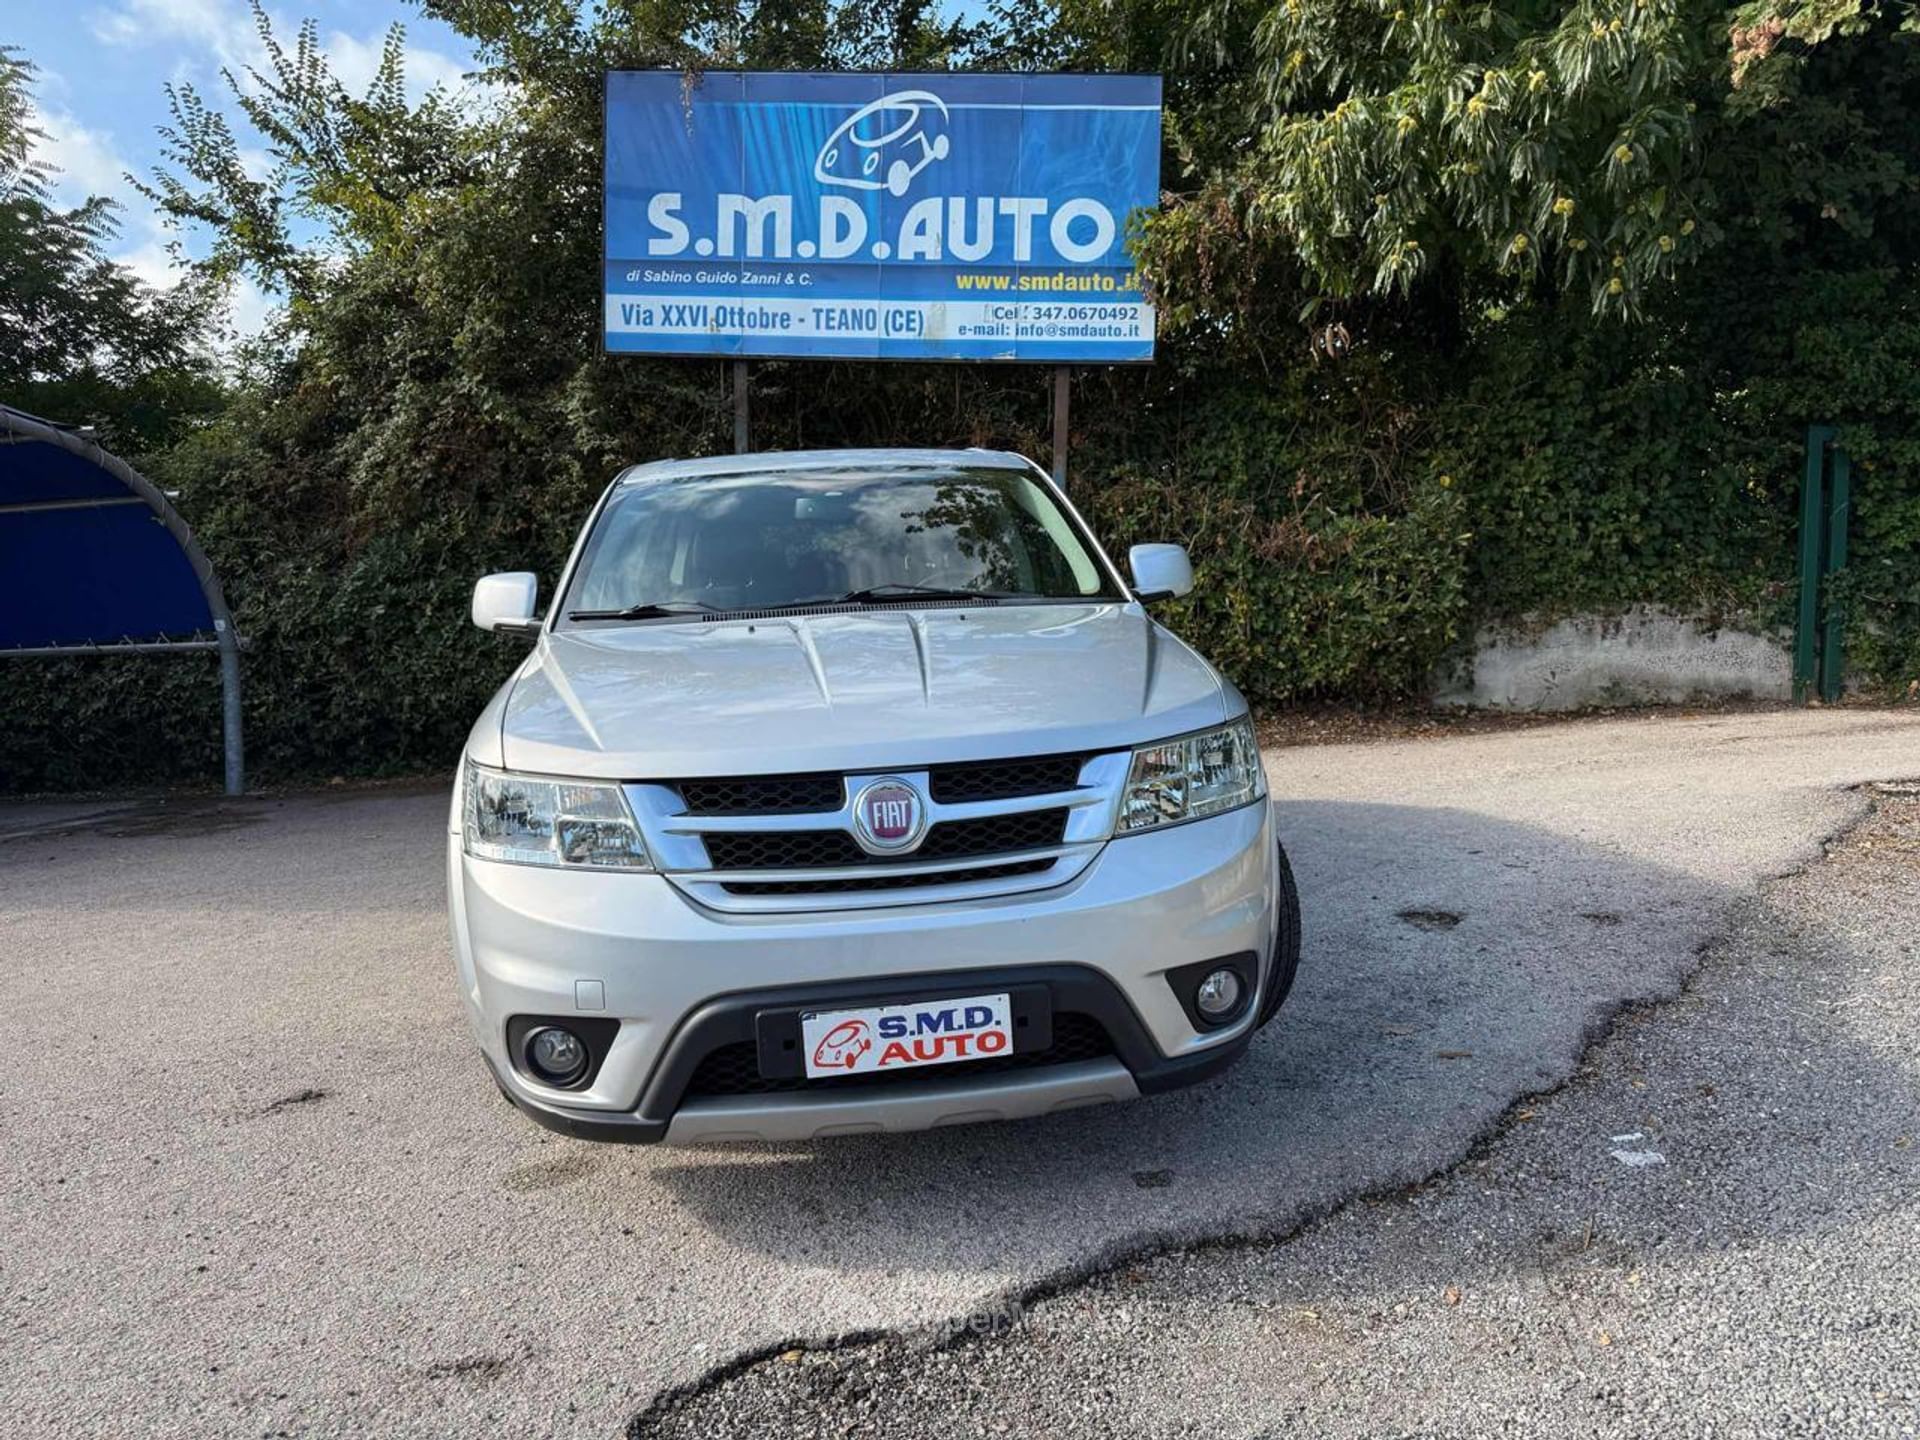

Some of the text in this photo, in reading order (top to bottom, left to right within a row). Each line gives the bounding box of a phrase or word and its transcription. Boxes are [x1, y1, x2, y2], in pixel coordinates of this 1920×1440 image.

[626, 269, 813, 286] di Sabino Guido Zanni & C.
[956, 272, 1141, 292] www.smdauto.it
[621, 303, 653, 327] Via
[661, 305, 708, 328] XXVI
[715, 305, 791, 330] Ottobre
[812, 307, 877, 332] TEANO
[884, 308, 925, 337] (CE)
[1033, 306, 1139, 321] 347.0670492
[957, 323, 1140, 338] e-mail: info@smdauto.it
[872, 800, 908, 829] FIAT
[878, 1005, 1001, 1039] S.M.D.
[878, 1030, 1006, 1066] AUTO
